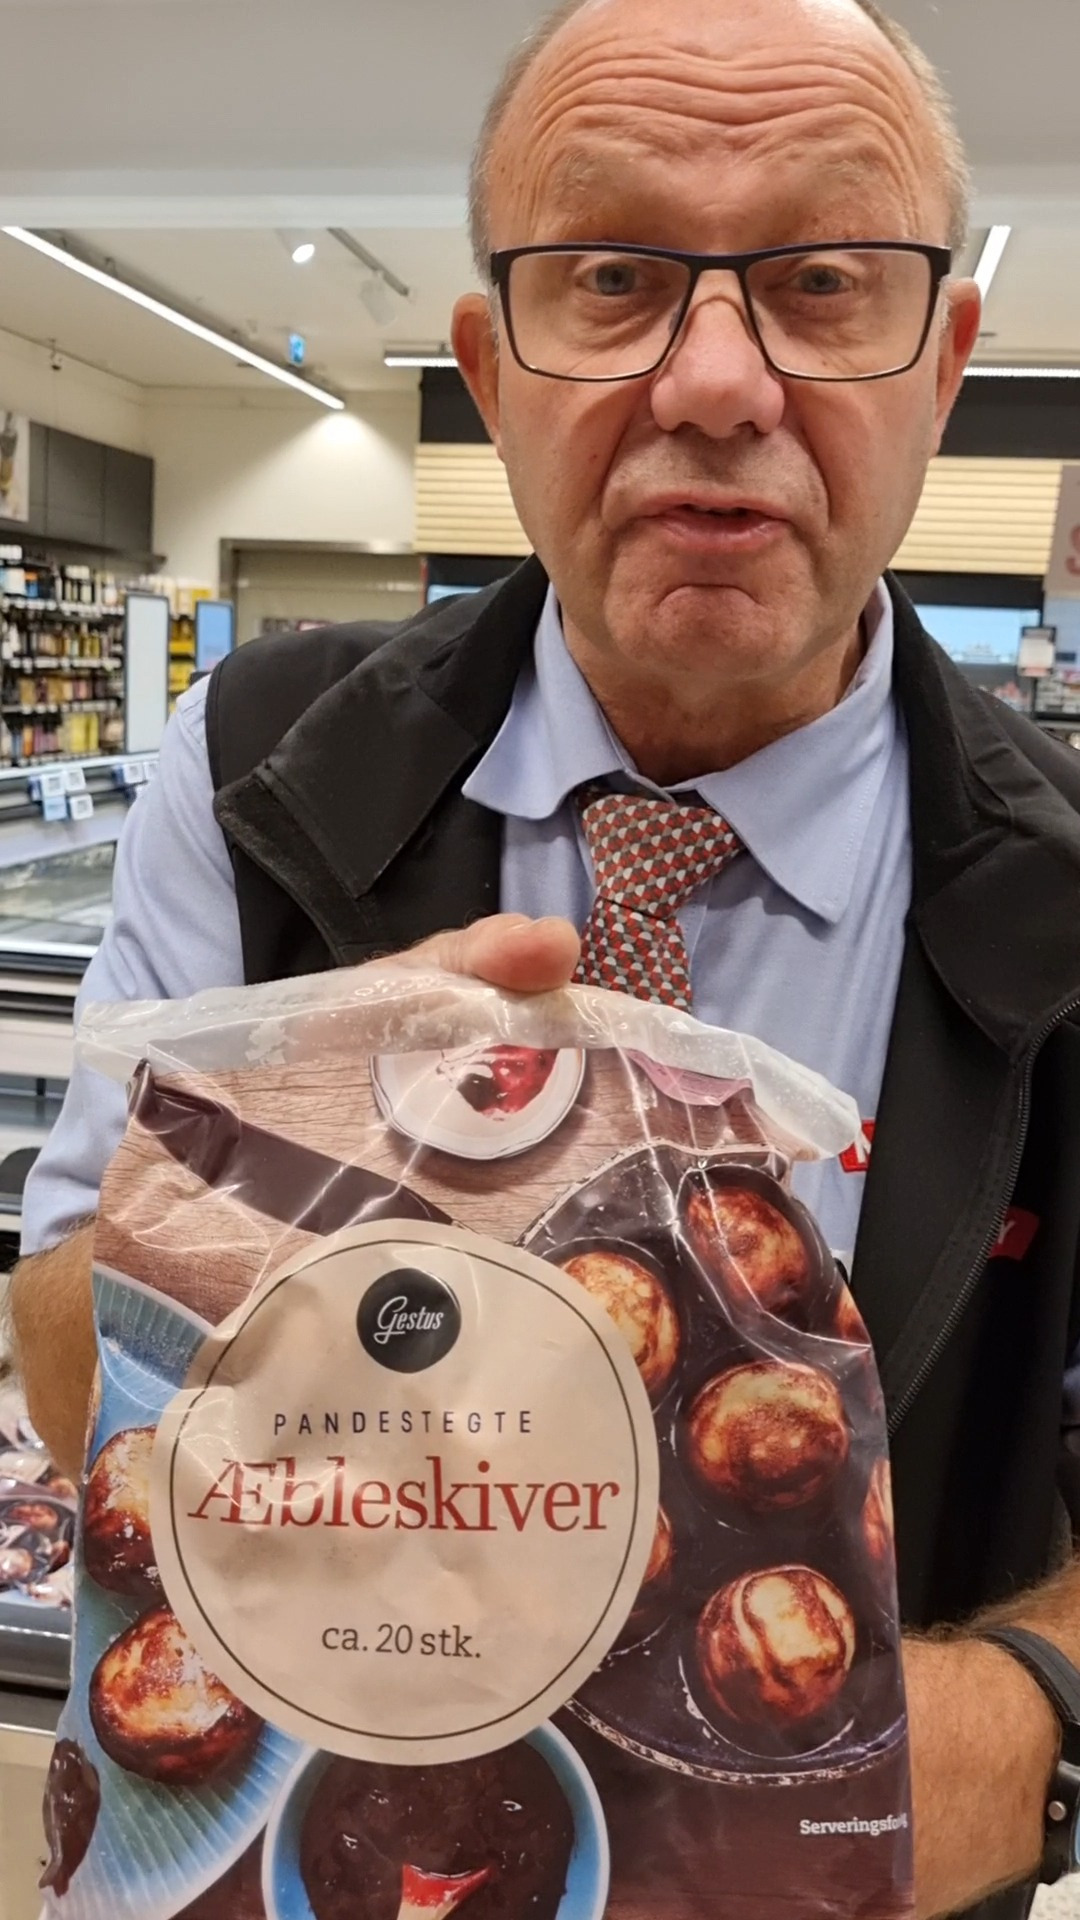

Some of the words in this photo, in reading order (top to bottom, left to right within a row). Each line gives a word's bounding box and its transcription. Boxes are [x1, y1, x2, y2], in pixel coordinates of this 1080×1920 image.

[373, 1295, 445, 1345] Gestus
[273, 1410, 534, 1436] PANDESTEGTE
[187, 1455, 621, 1532] Æbleskiver
[320, 1625, 369, 1652] ca.
[375, 1623, 414, 1655] 20
[419, 1624, 482, 1658] stk.
